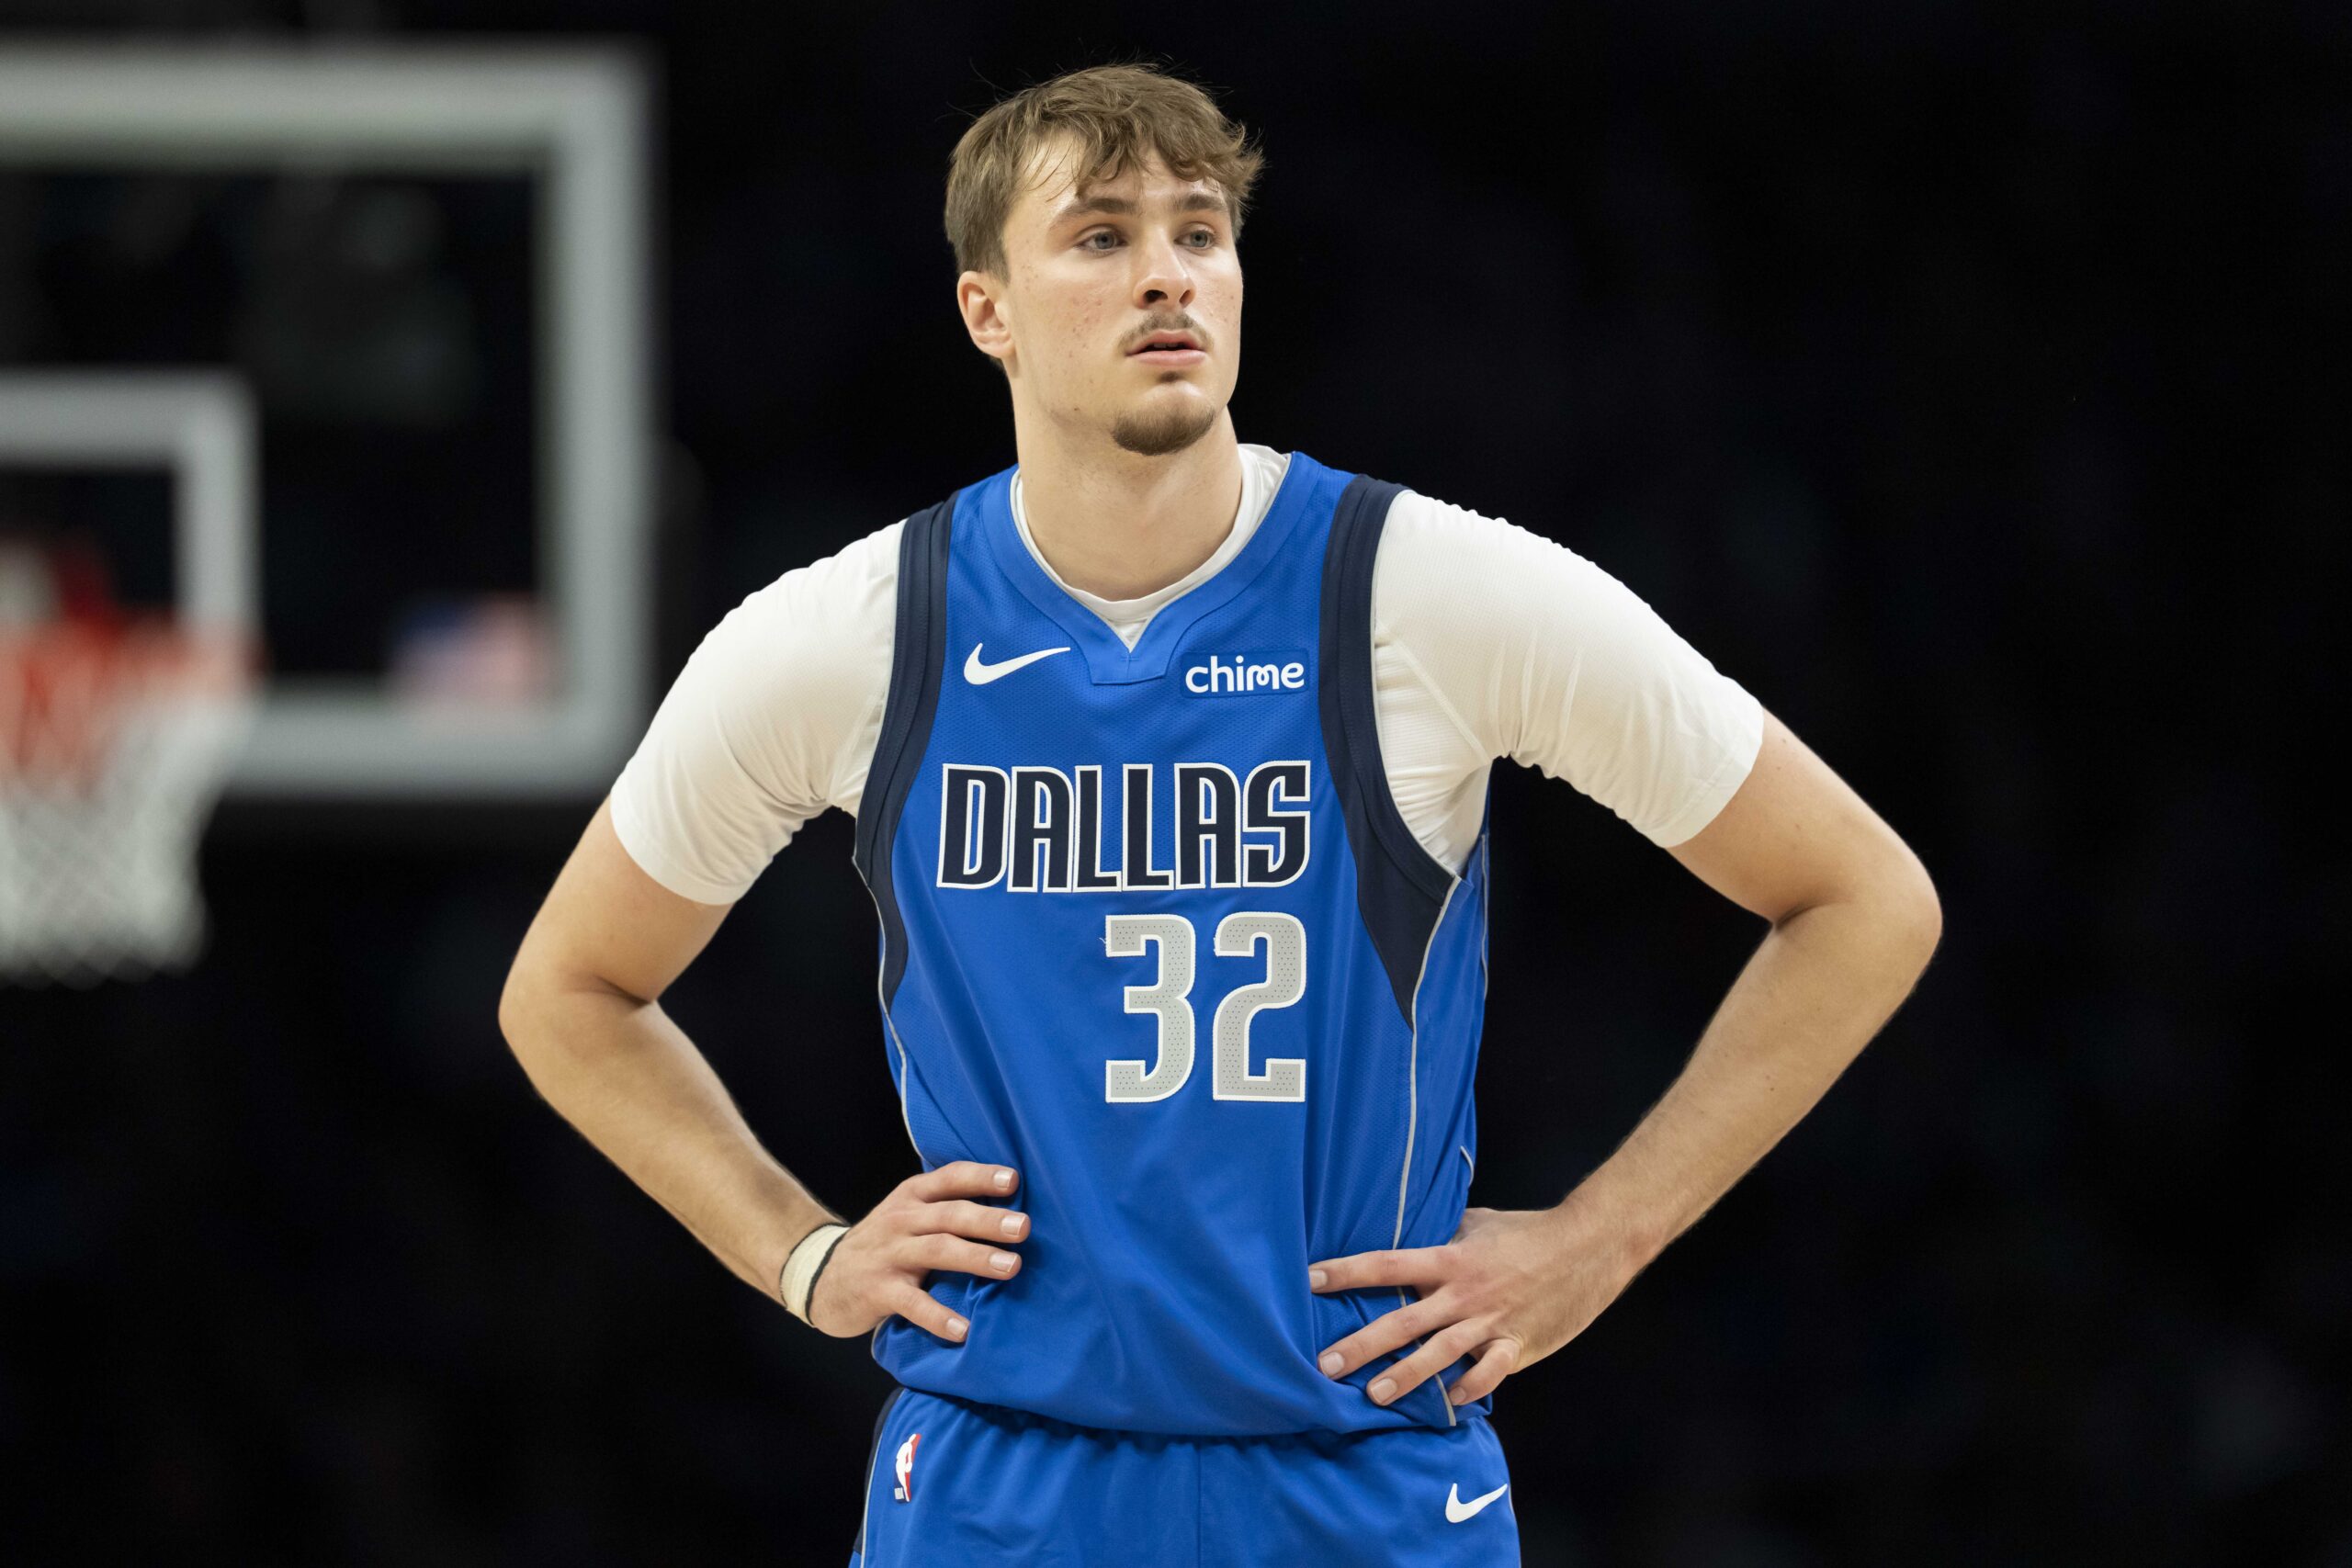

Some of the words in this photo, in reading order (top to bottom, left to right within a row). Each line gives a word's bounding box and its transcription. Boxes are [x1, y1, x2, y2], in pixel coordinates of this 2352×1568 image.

[1185, 655, 1305, 694] chime
[936, 760, 1311, 893] DALLAS
[1105, 911, 1306, 1103] 32
